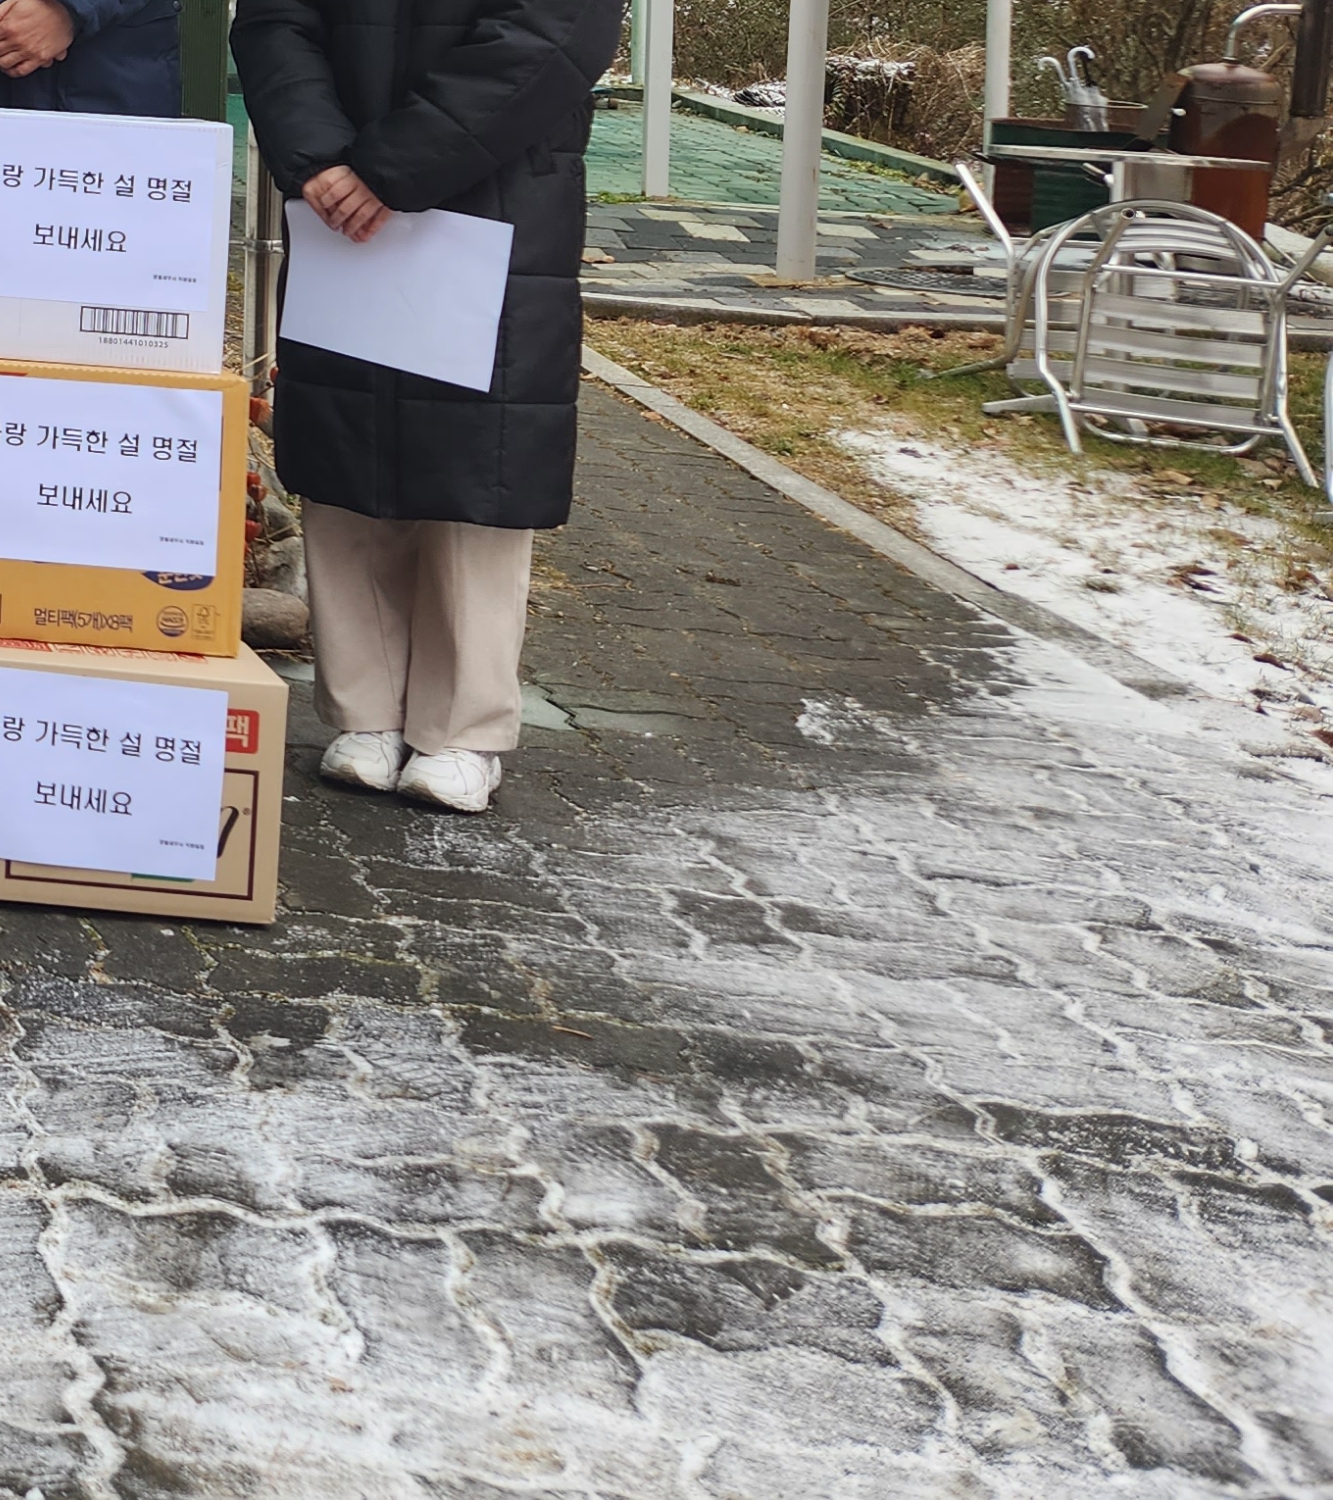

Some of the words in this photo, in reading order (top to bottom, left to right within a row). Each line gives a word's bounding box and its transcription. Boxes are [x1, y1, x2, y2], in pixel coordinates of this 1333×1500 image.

[34, 168, 103, 194] 가득한
[115, 175, 134, 197] 설
[148, 178, 191, 202] 명절
[34, 224, 126, 252] 보내세요
[37, 426, 108, 453] 가득한
[119, 434, 139, 457] 설
[153, 437, 197, 462] 명절
[37, 484, 131, 513] 보내세요
[36, 721, 108, 752] 가득한
[121, 733, 141, 757] 설
[156, 737, 200, 765] 명절
[226, 714, 250, 748] 팩
[35, 782, 131, 815] 보내세요
